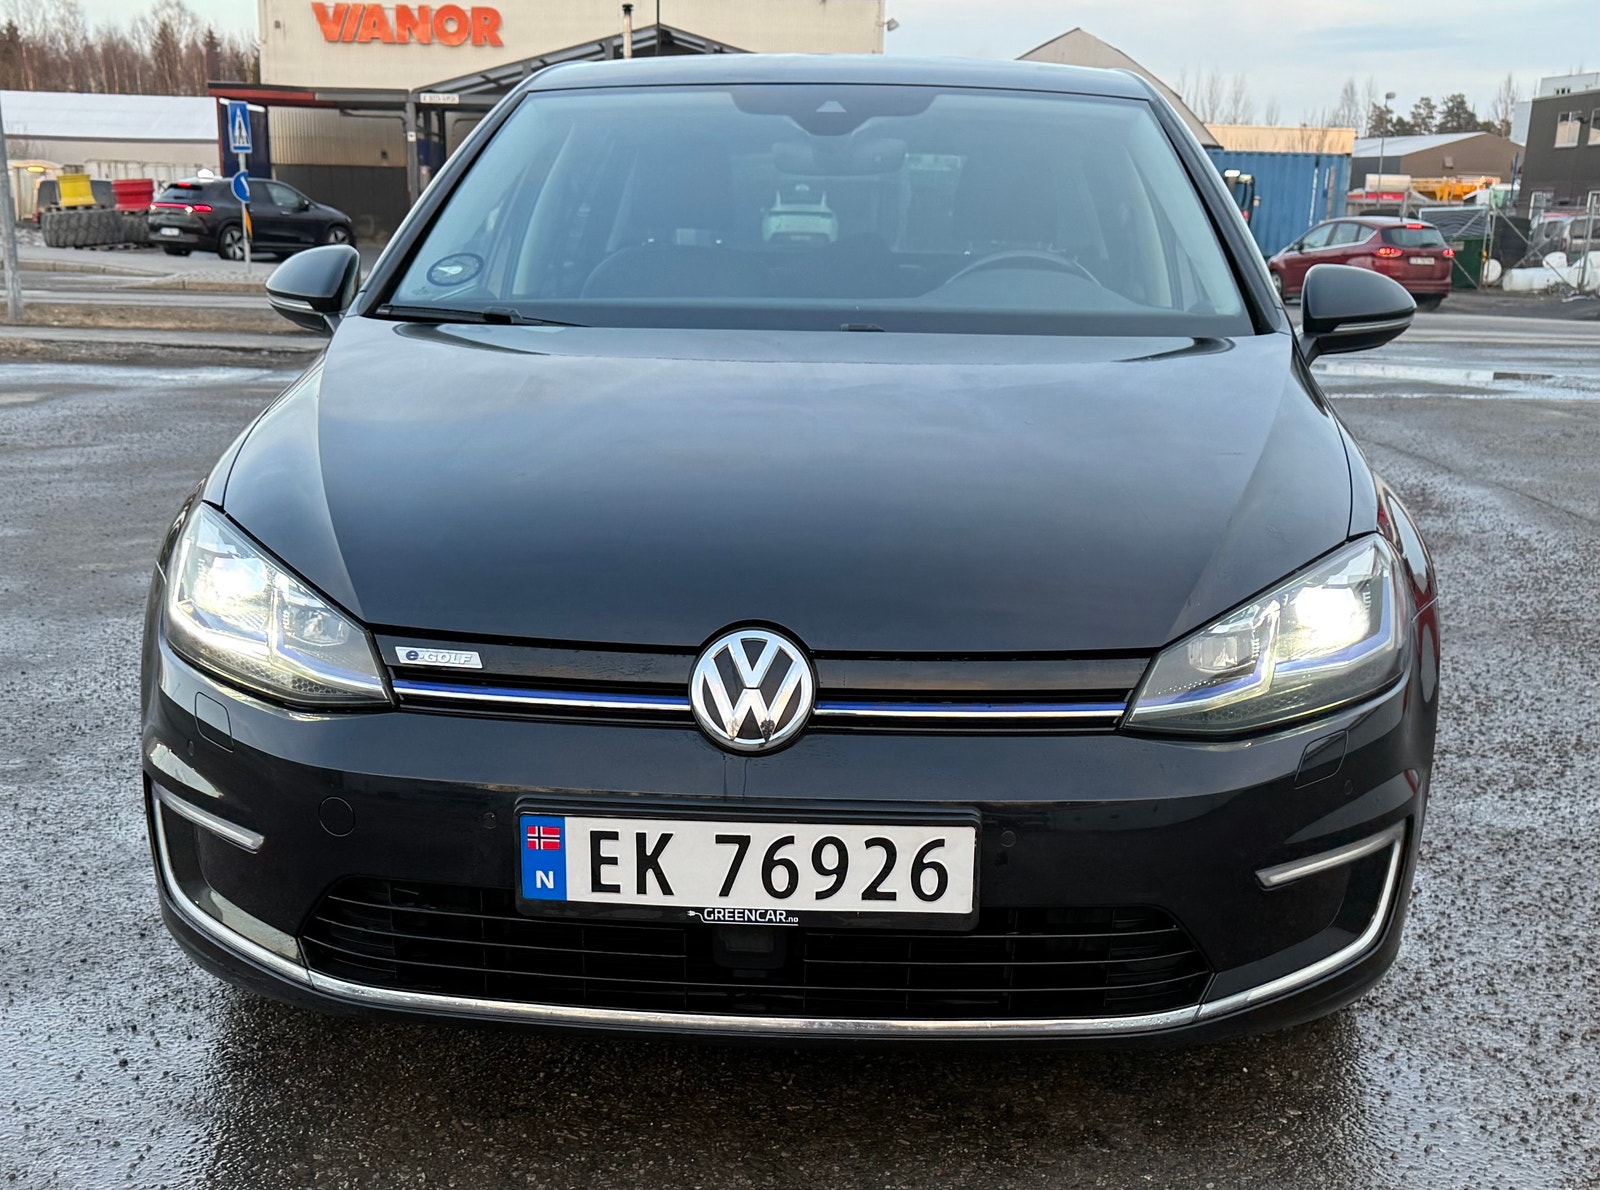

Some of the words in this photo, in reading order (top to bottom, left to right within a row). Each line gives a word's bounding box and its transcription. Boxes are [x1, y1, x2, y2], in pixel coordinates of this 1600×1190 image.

[311, 2, 504, 47] VIANOR
[535, 870, 555, 889] N
[589, 829, 675, 896] EK
[714, 834, 949, 902] 76926
